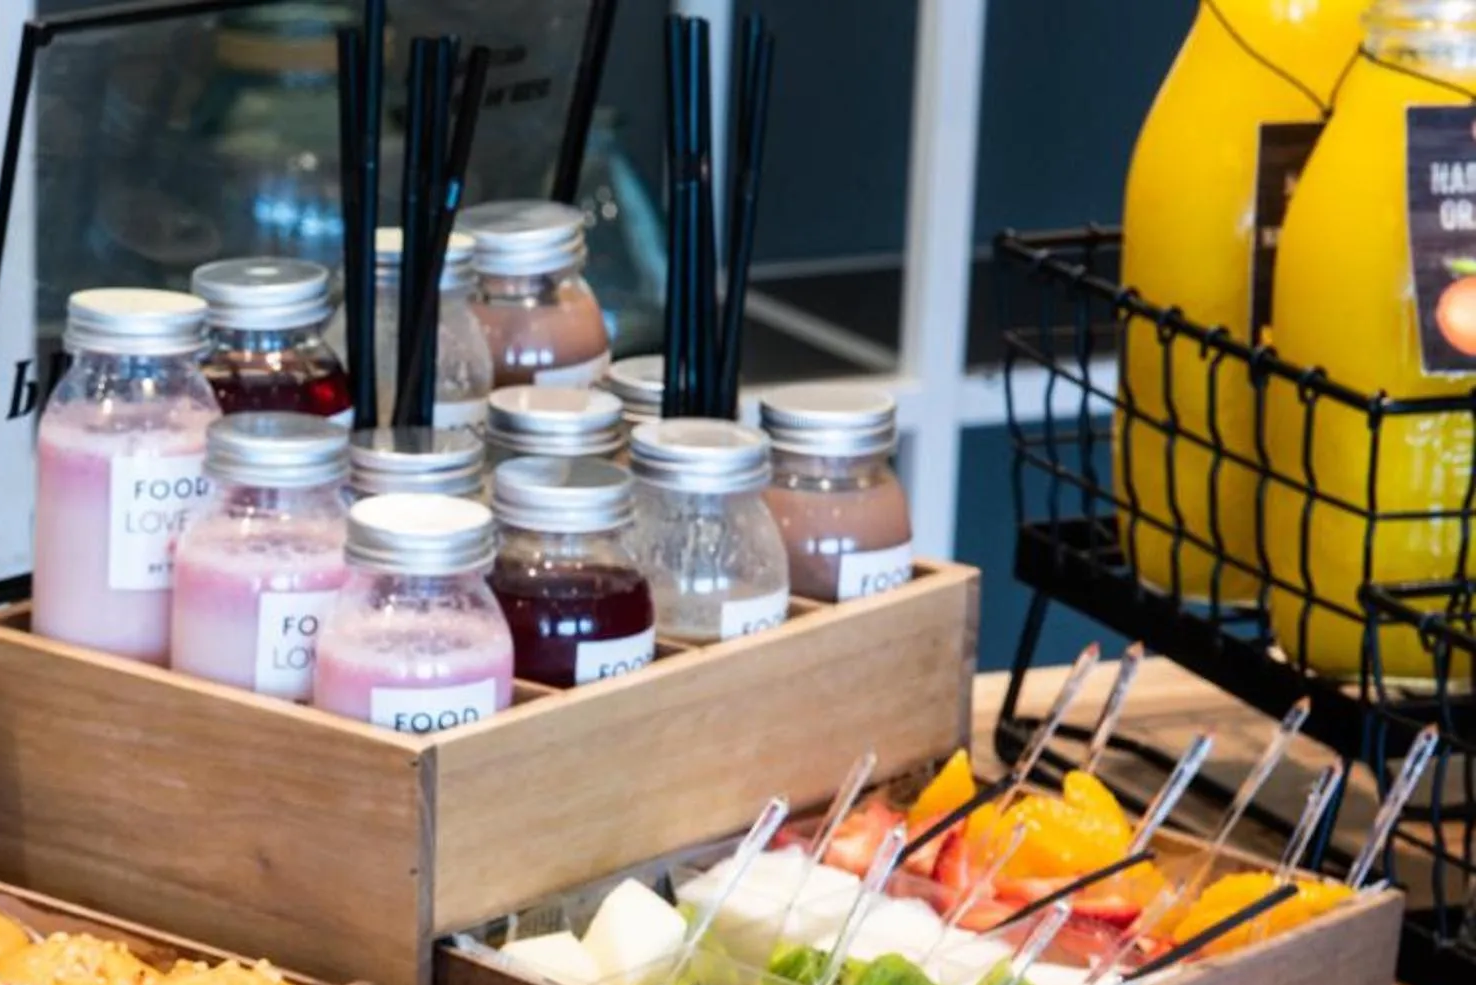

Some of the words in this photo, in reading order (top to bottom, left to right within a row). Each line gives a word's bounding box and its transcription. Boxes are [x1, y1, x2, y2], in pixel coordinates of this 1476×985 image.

[134, 477, 209, 500] FOOD
[125, 508, 191, 535] LOVE
[282, 614, 319, 637] FO
